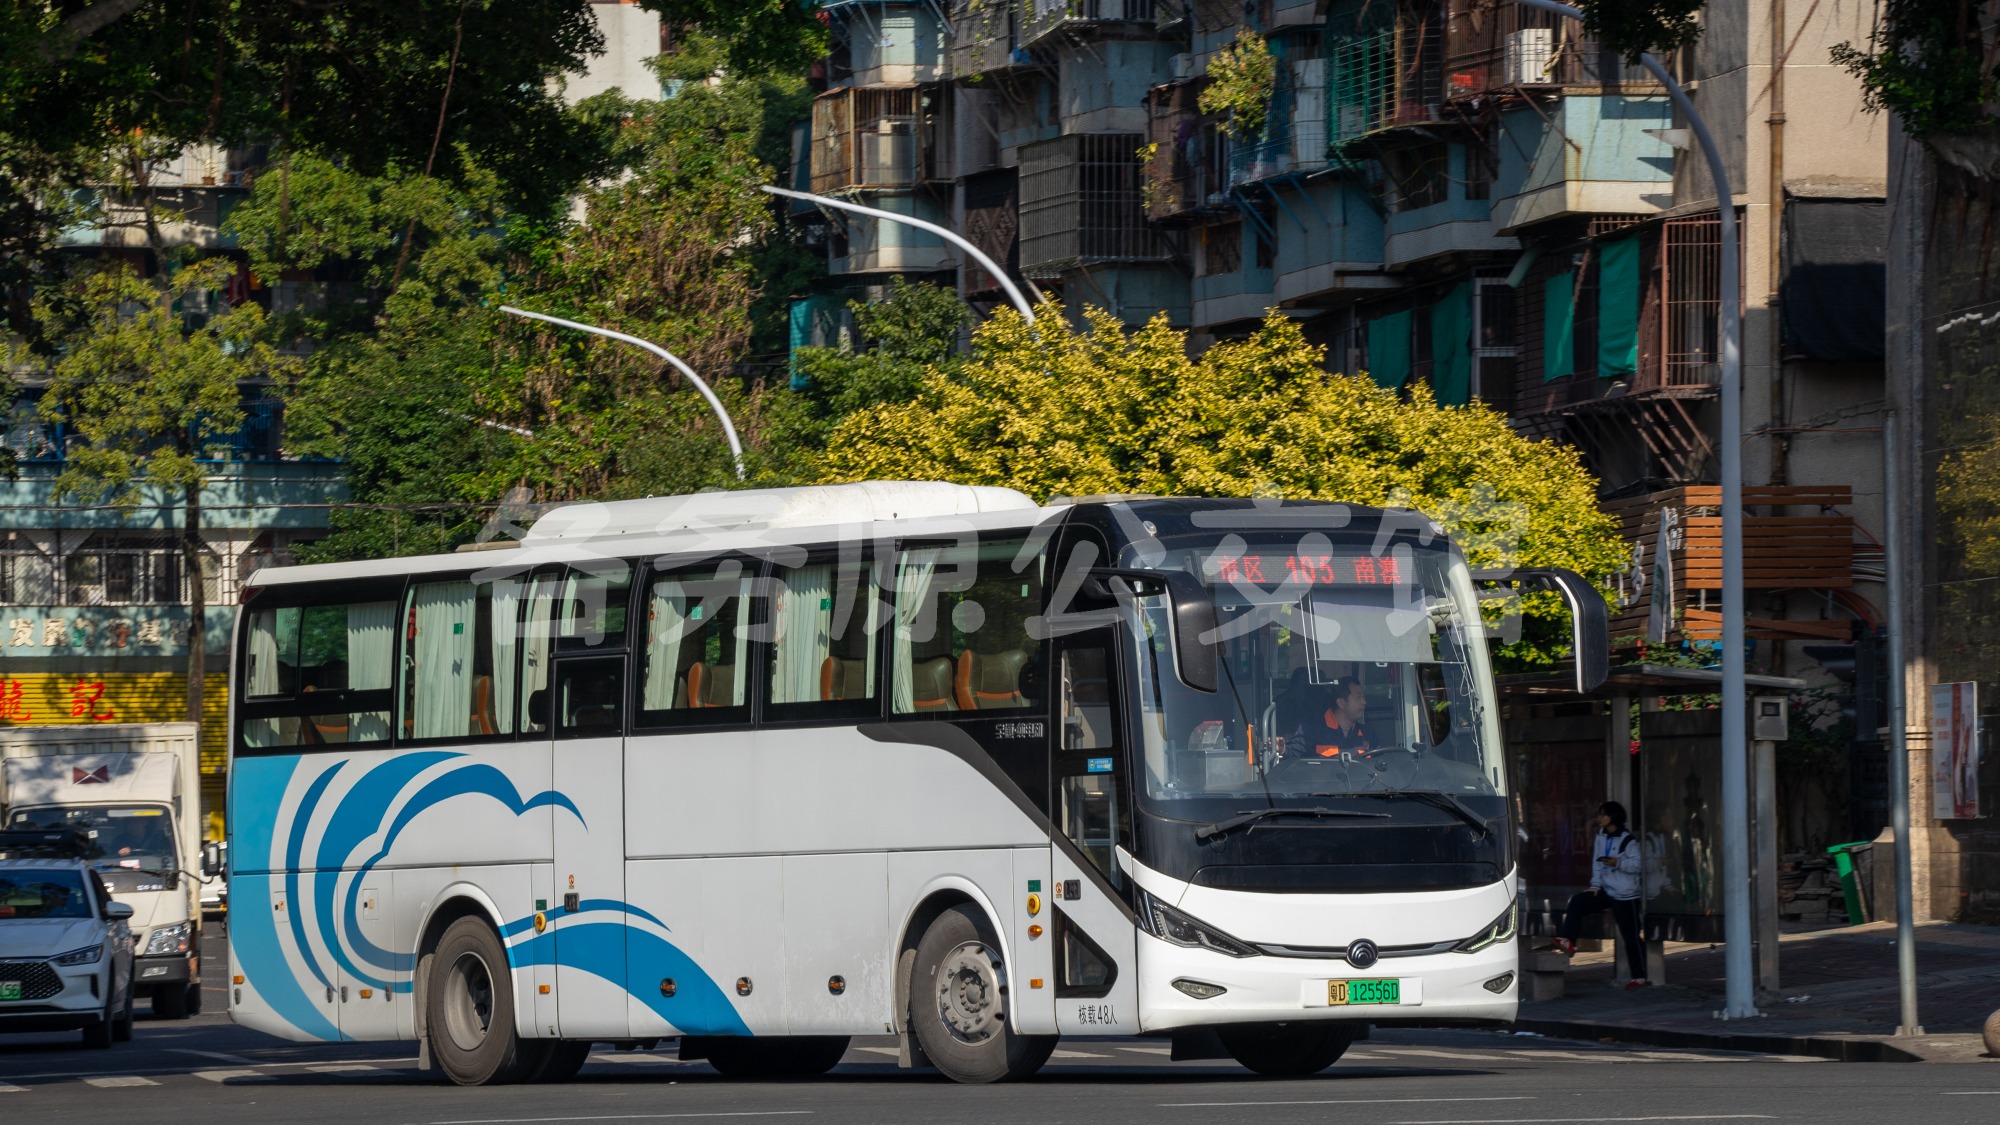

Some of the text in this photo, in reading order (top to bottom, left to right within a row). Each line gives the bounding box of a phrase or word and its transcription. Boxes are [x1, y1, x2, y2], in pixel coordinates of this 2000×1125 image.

[1217, 555, 1402, 585] 市区 105 南澳
[1078, 1004, 1118, 1026] 核载48人
